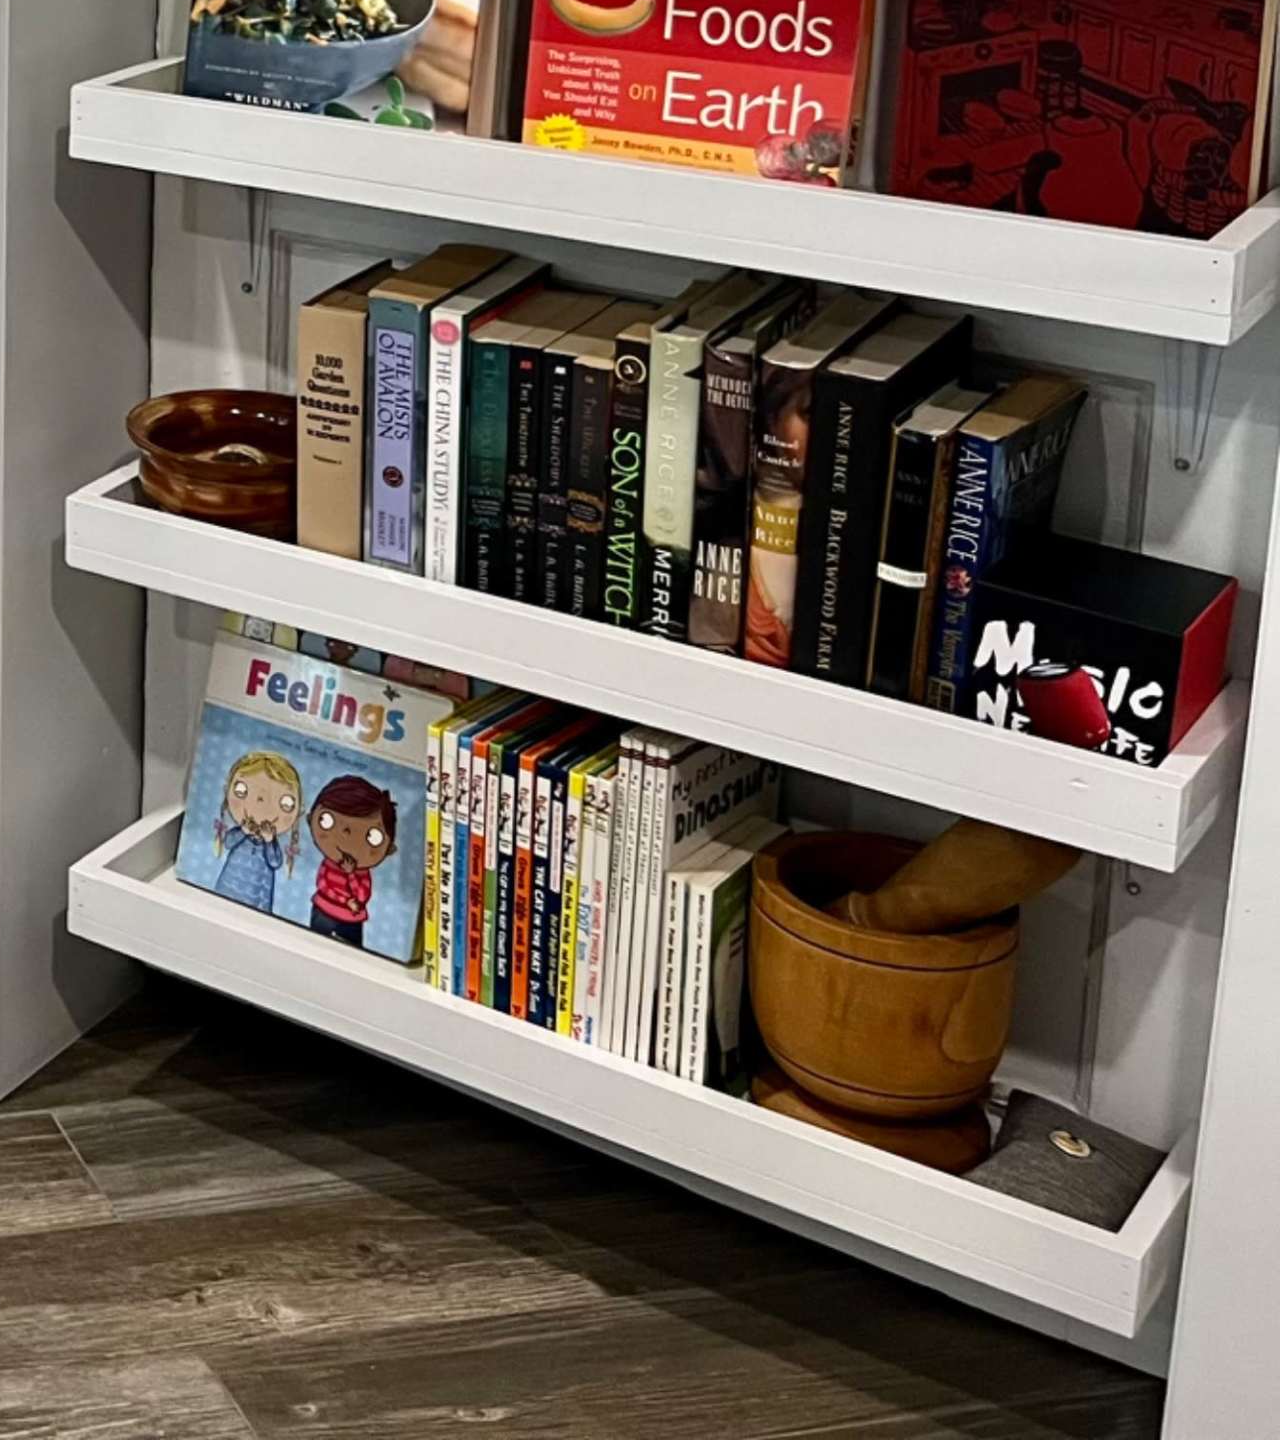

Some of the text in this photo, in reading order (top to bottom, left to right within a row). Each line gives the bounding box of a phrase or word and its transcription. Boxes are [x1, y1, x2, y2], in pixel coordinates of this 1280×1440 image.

[547, 48, 566, 62] The
[541, 88, 562, 101] You
[626, 69, 826, 137] on Earth
[375, 331, 395, 441] OF AVALON
[435, 349, 452, 386] THE
[706, 373, 752, 395] MEMNOC
[393, 342, 413, 441] THE MISTS
[706, 387, 725, 405] THE
[433, 388, 451, 445] CHINA
[657, 340, 682, 502] ANNE RICE
[609, 428, 641, 498] SON
[611, 497, 633, 516] of
[613, 517, 628, 529] a
[754, 504, 797, 526] Anne
[946, 445, 989, 564] ANNE RICE
[754, 526, 795, 547] Rice
[815, 400, 853, 673] ANNE RICE BLACKWOOD FARM
[695, 539, 743, 576] ANNE
[603, 531, 637, 626] WITCH
[649, 548, 674, 639] MERRI
[692, 568, 742, 606] RICE
[943, 600, 967, 624] The
[972, 620, 1165, 720] MSIC
[245, 658, 407, 745] Feelings
[534, 864, 545, 886] THE
[439, 842, 452, 960] Put Me the Zoo
[533, 888, 545, 911] CAT
[577, 901, 592, 935] FOOT
[532, 927, 542, 947] THE
[530, 949, 541, 975] HAT
